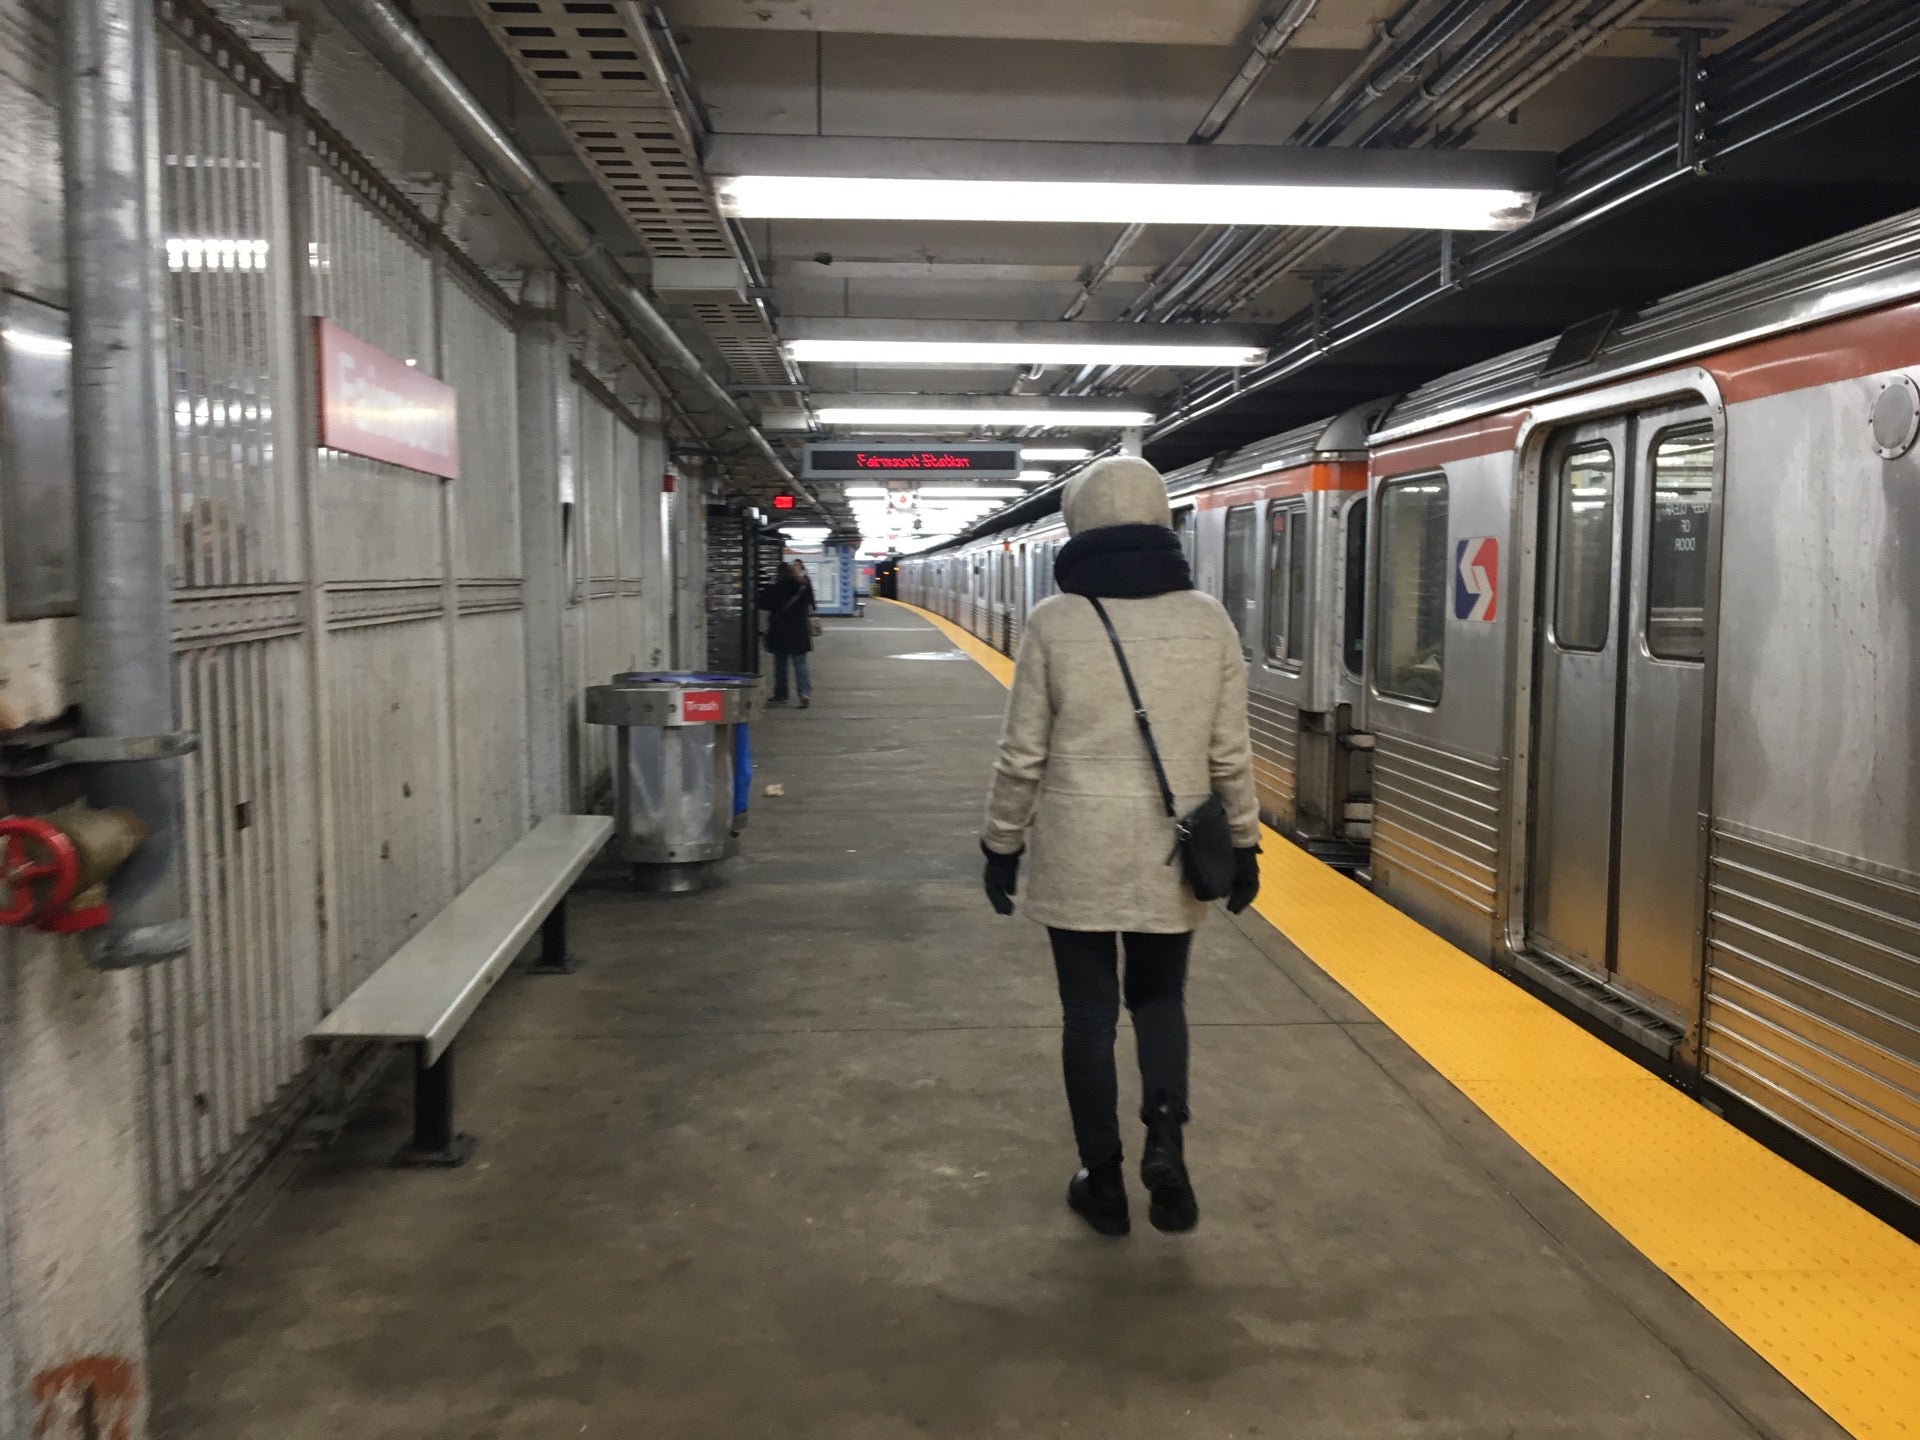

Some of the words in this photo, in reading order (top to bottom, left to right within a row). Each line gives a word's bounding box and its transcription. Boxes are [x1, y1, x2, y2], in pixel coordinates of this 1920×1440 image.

[856, 453, 920, 468] Fairmount
[921, 453, 970, 468] Station
[685, 700, 720, 711] Trash
